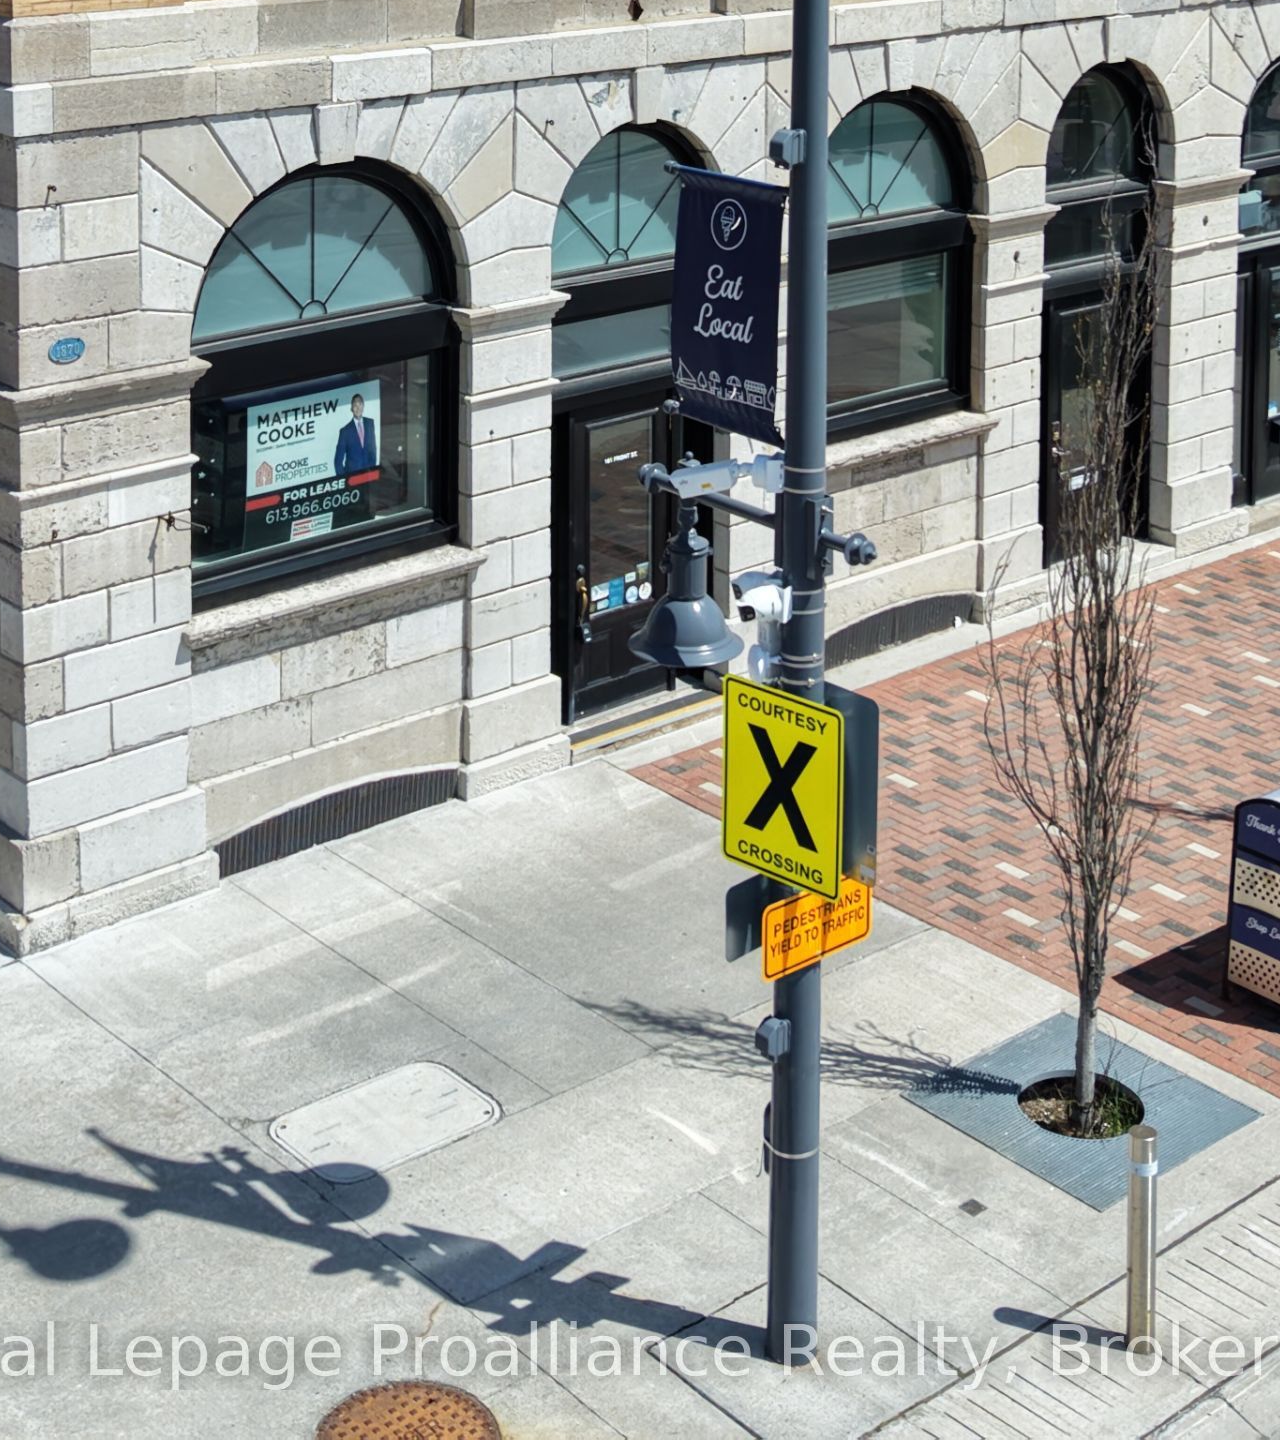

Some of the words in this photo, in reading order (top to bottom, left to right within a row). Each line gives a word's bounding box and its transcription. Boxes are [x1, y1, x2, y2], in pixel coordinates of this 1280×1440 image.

[704, 264, 743, 301] Eat
[693, 302, 754, 344] Local
[56, 342, 80, 359] 1870
[257, 399, 339, 429] MATTHEW
[257, 421, 315, 445] COOKE
[275, 457, 309, 473] COOKE
[275, 462, 328, 483] PROPERTIES
[265, 489, 360, 525] 613.966.6060
[283, 489, 307, 503] FOR
[310, 479, 346, 495] LEASE
[738, 692, 827, 735] COURTESY
[743, 722, 818, 853] X
[1245, 814, 1277, 836] Thank
[738, 839, 823, 884] CROSSING
[774, 889, 861, 938] PEDESTRIANS
[1245, 916, 1268, 935] Shop
[770, 933, 801, 958] YIELD
[804, 926, 819, 943] TO
[822, 905, 865, 936] TRAFFIC
